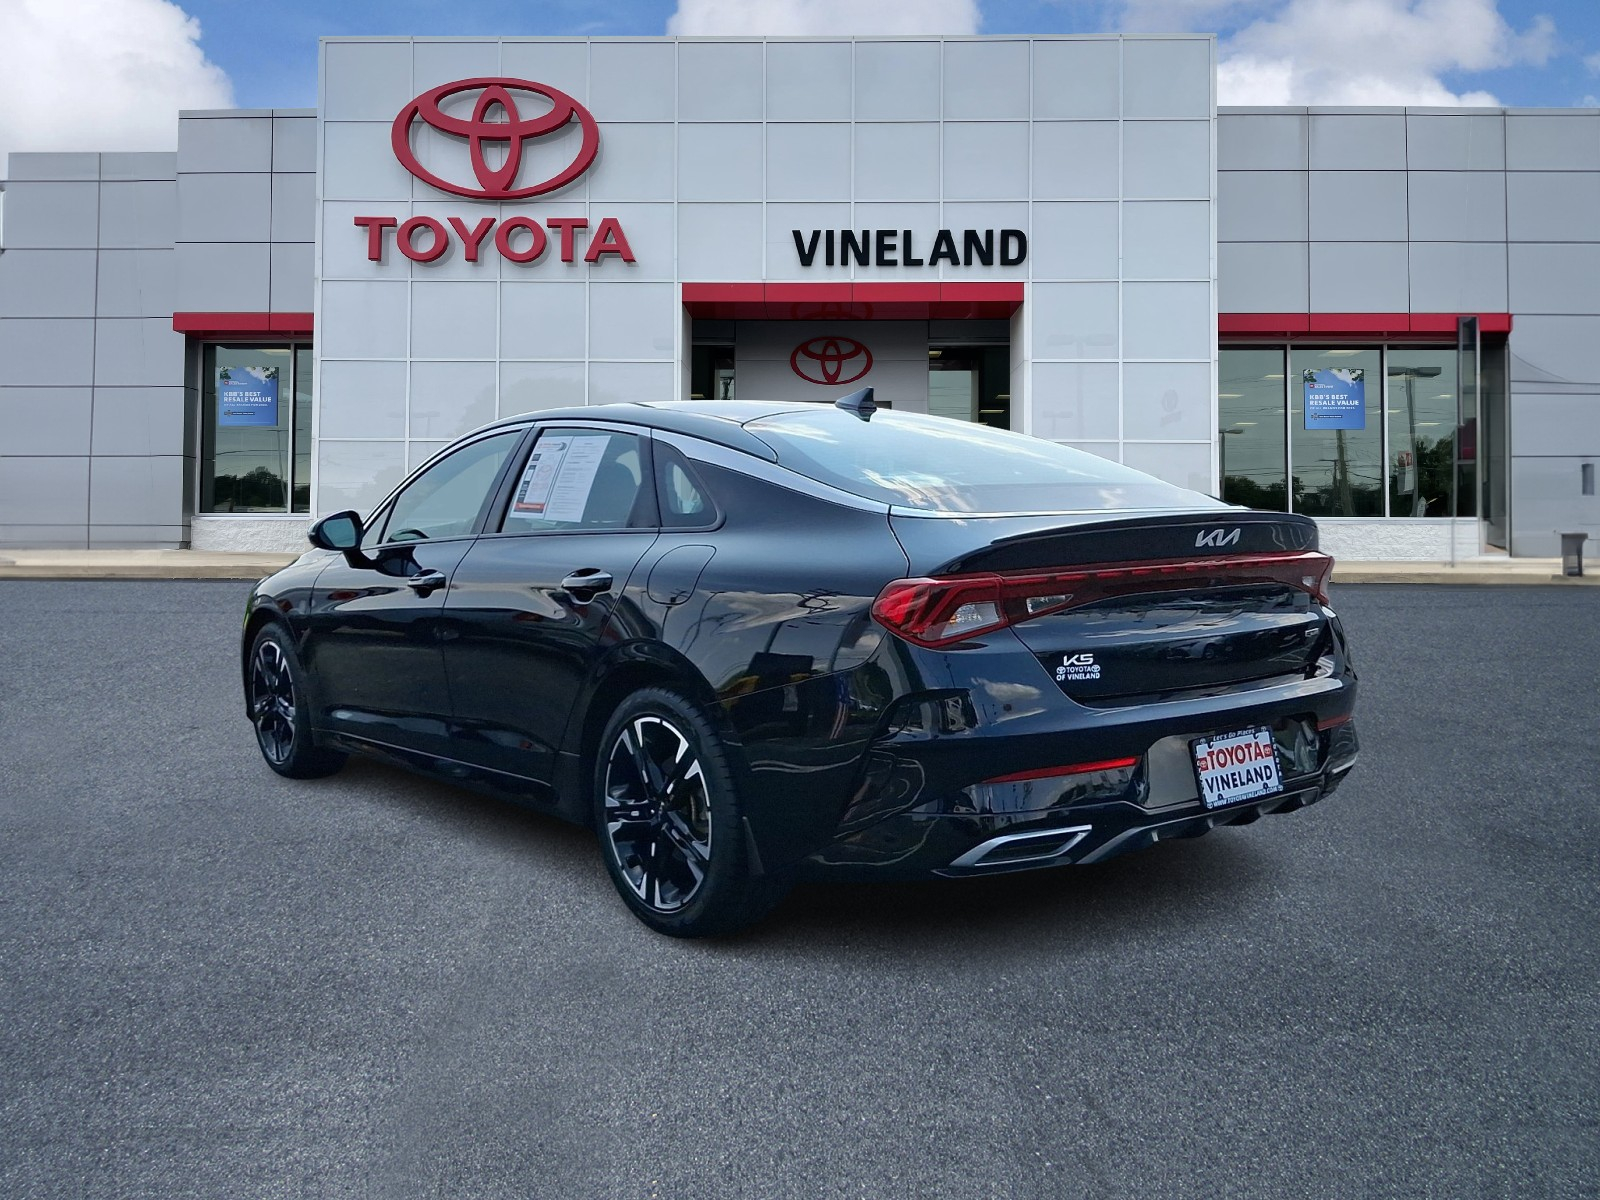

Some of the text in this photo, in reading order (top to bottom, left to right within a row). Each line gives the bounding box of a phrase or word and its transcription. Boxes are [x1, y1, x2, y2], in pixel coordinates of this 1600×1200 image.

[354, 216, 636, 263] TOYOTA
[792, 229, 1027, 266] VINELAND
[1064, 654, 1094, 666] K5
[1213, 733, 1227, 742] Let's
[1237, 728, 1255, 737] Places
[1207, 741, 1264, 770] TOYOTA
[1205, 764, 1273, 794] VINELAND
